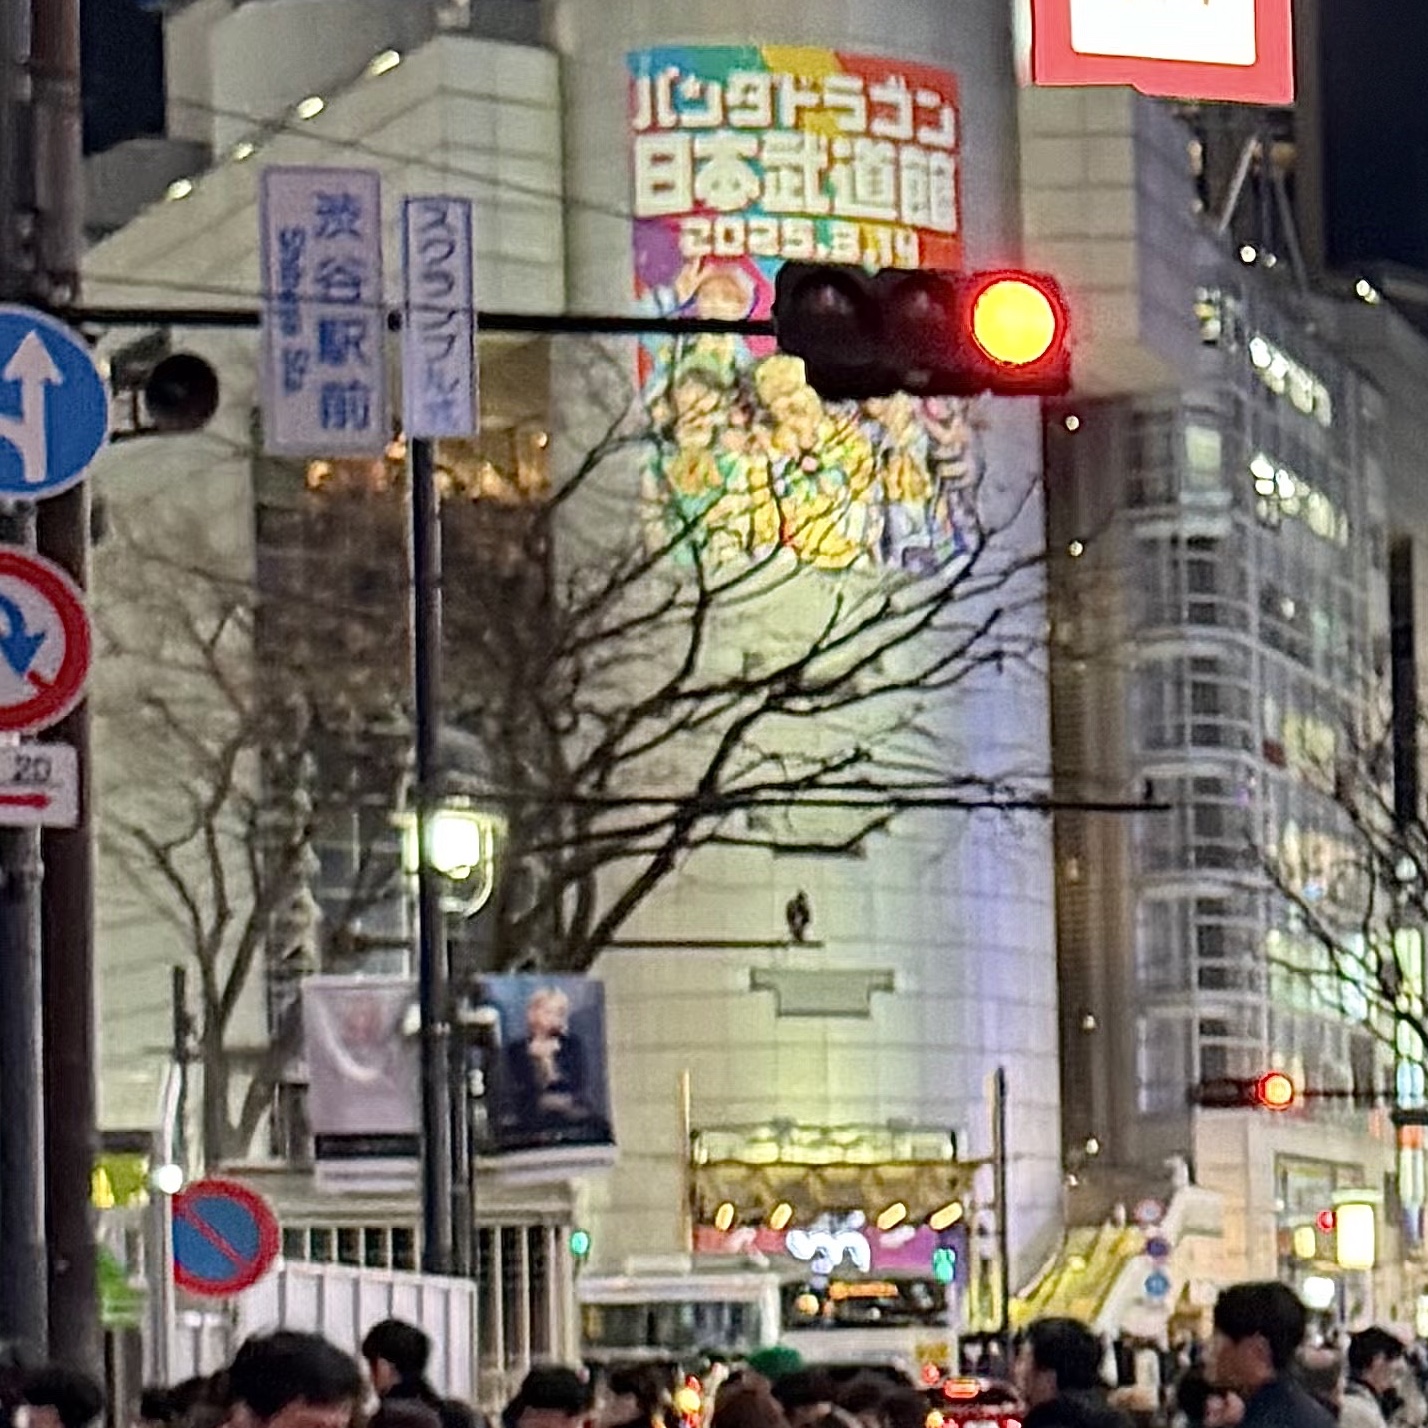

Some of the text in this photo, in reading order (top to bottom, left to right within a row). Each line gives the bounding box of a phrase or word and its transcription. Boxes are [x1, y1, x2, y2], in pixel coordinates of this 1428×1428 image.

[634, 129, 957, 232] 日本武道館
[313, 190, 372, 431] 渋谷駅前
